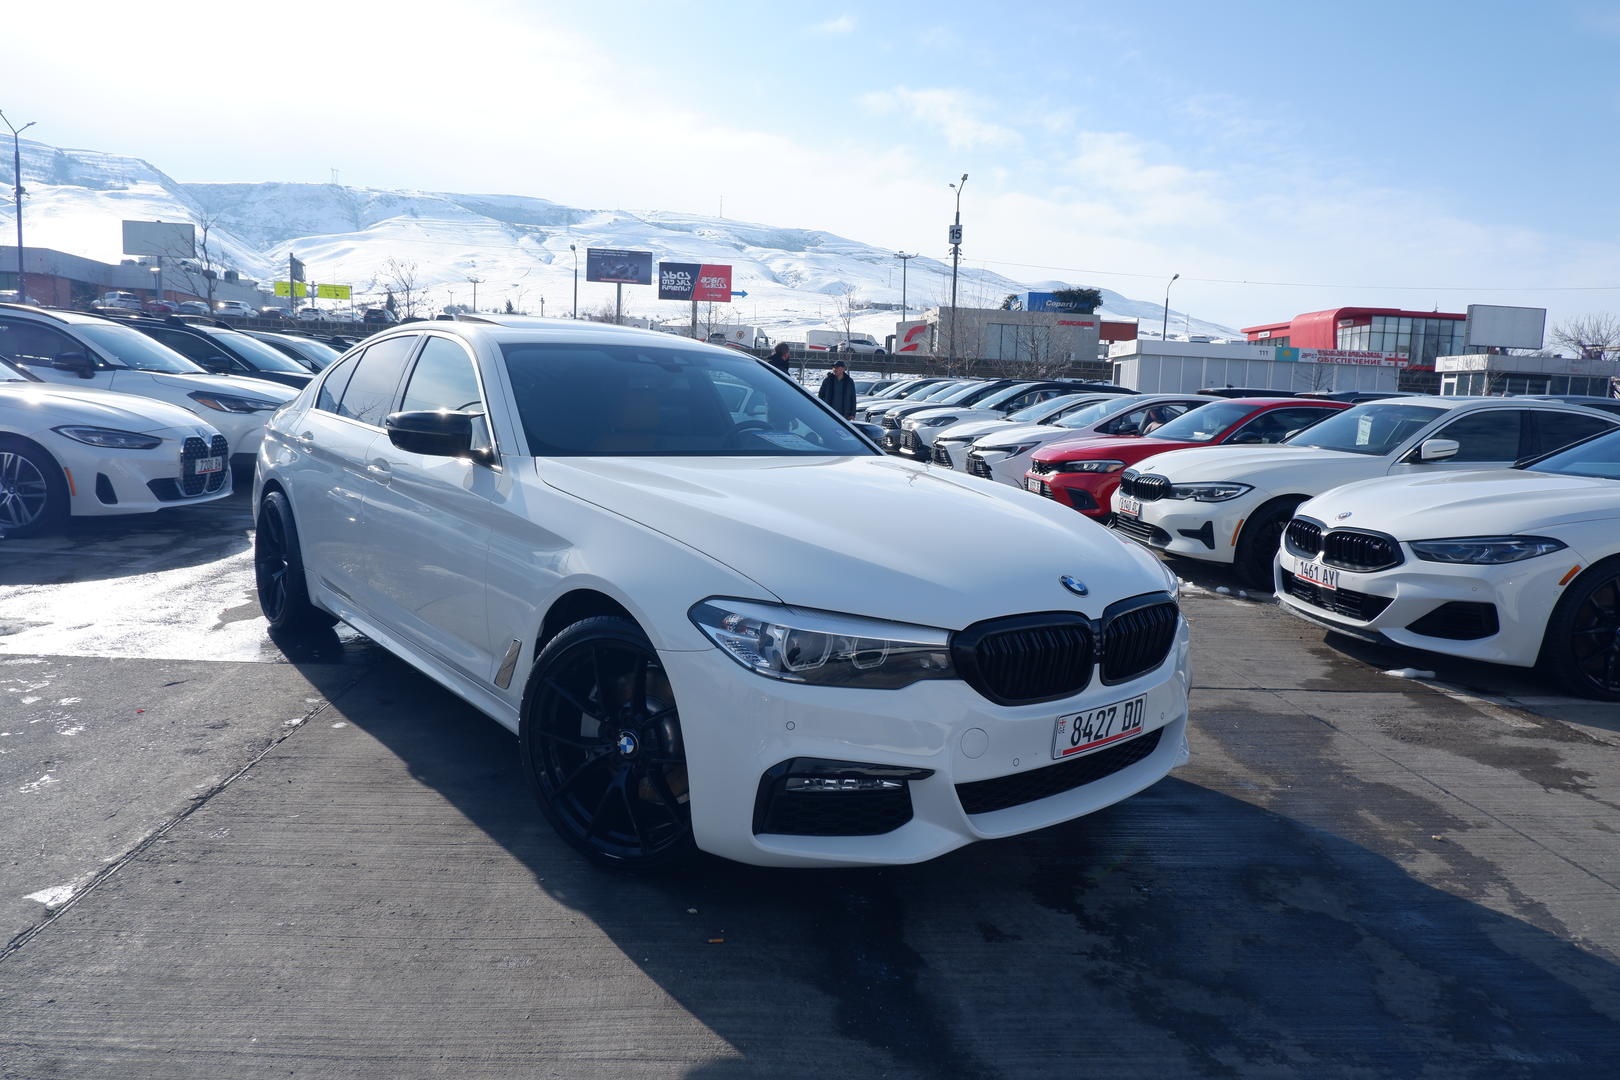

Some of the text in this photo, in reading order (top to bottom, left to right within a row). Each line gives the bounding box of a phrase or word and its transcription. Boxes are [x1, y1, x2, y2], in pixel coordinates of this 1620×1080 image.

[950, 229, 961, 240] 15
[1317, 357, 1383, 366] ОБЕСПЕЧЕНИЕ
[1300, 561, 1335, 586] 1461 AY
[1070, 698, 1143, 746] 8427 DD
